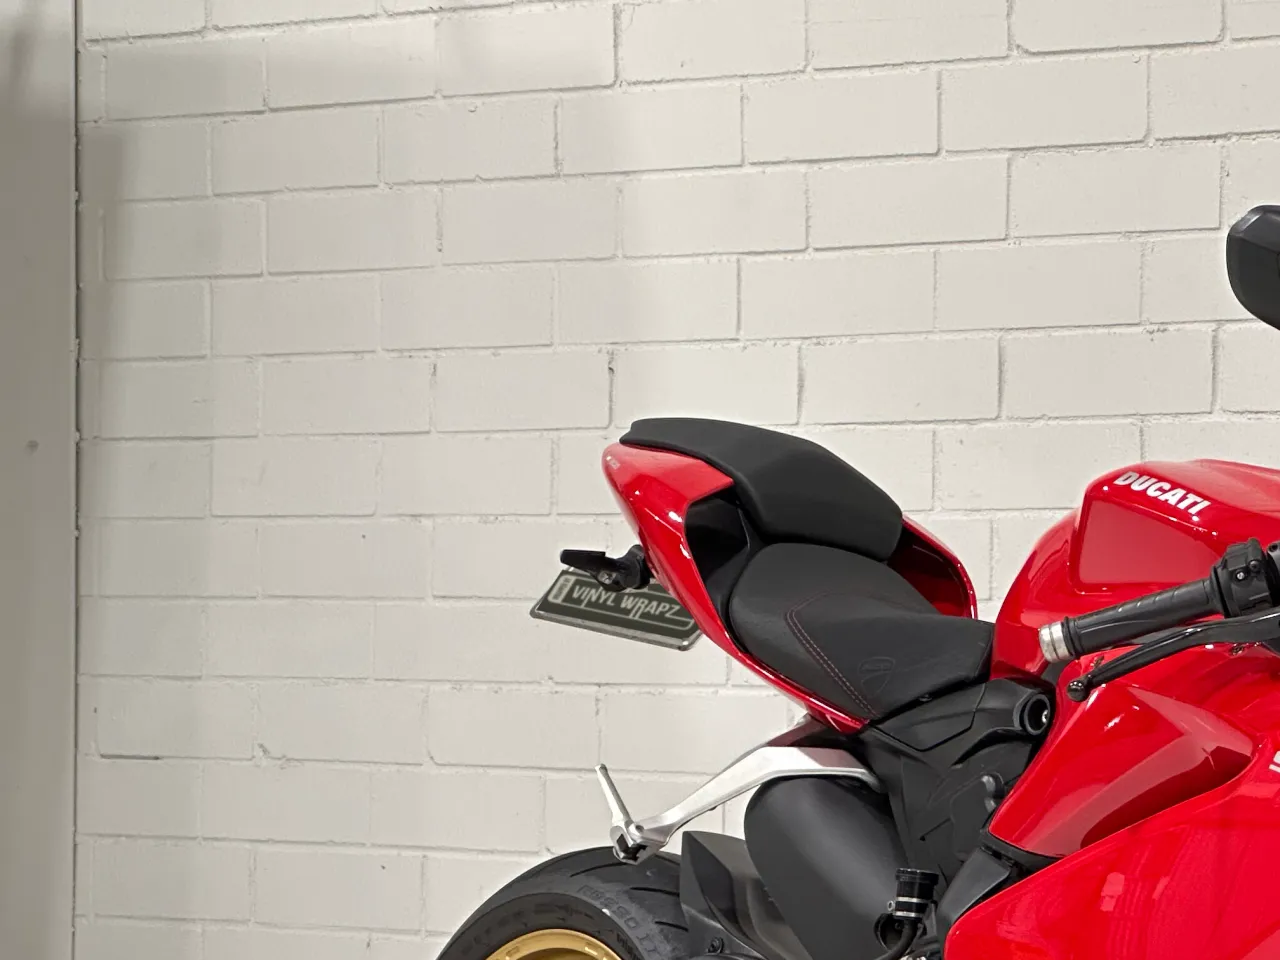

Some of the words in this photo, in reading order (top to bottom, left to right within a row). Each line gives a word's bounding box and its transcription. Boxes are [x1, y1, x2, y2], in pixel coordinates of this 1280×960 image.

[1113, 471, 1211, 514] DUCATI
[572, 585, 616, 607] VINYL
[620, 594, 681, 618] WRAPZ
